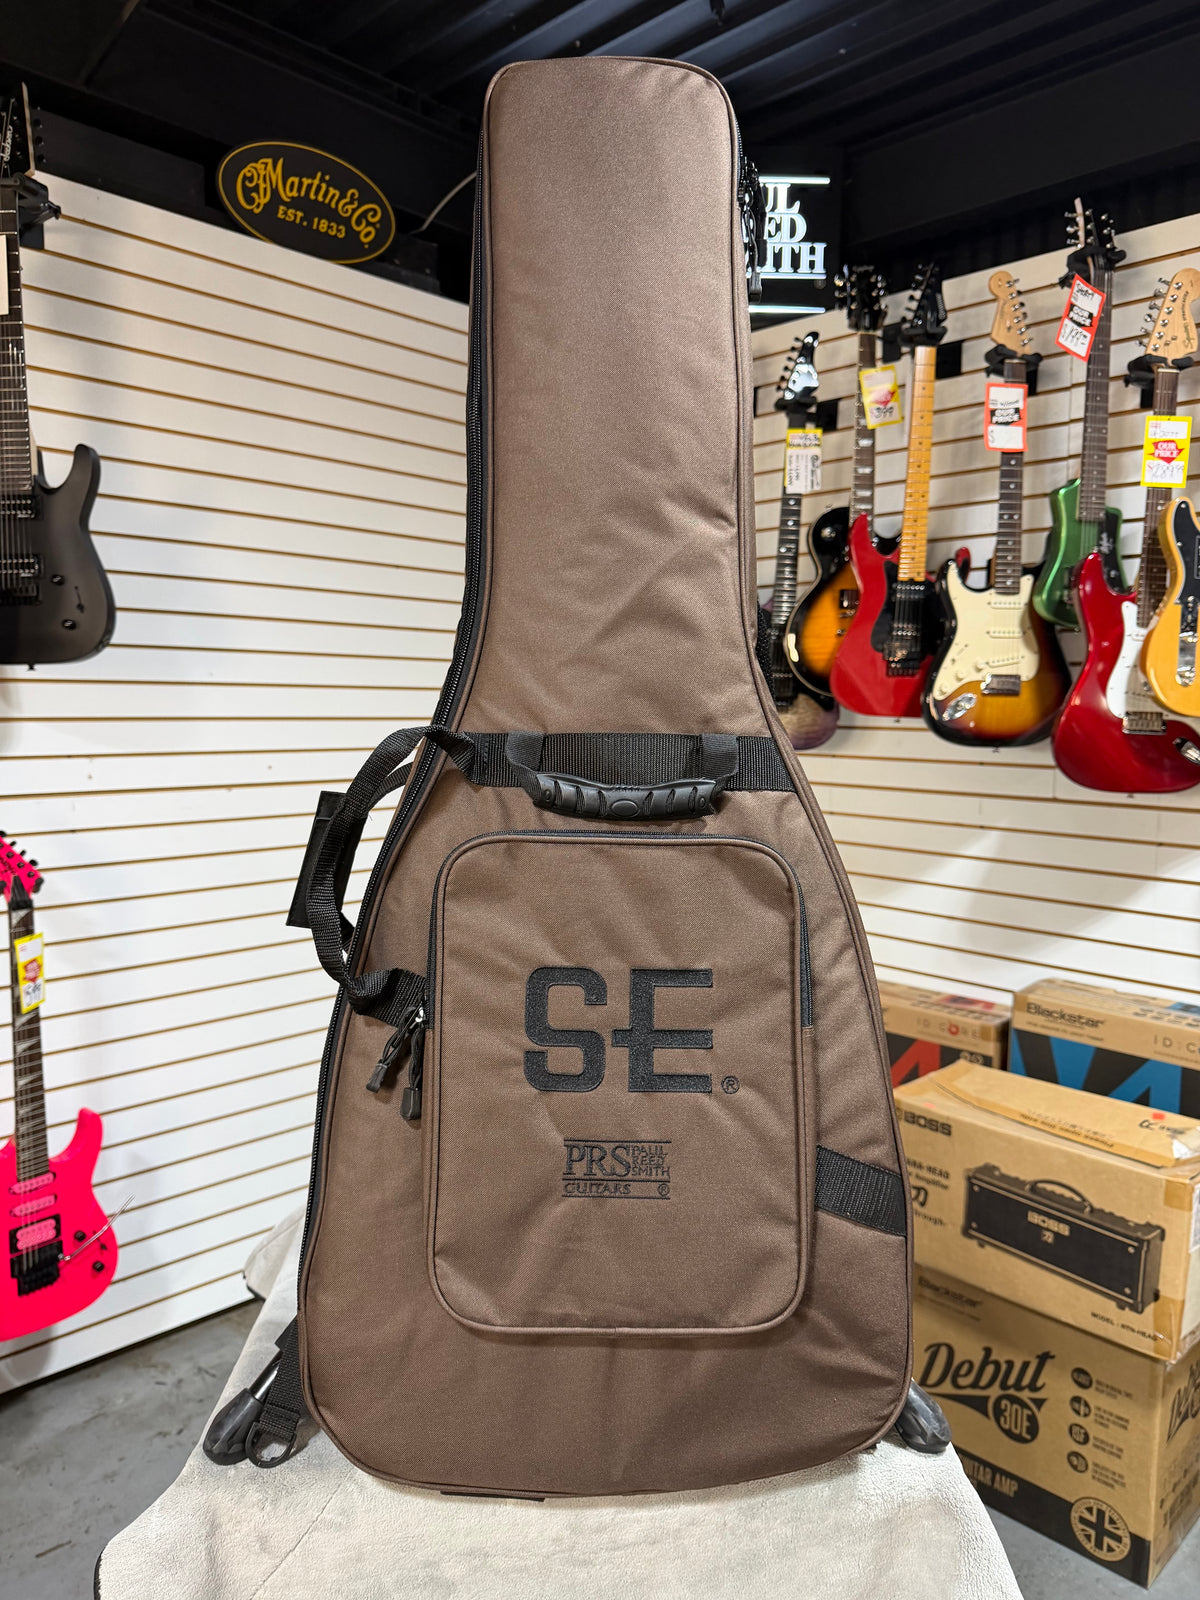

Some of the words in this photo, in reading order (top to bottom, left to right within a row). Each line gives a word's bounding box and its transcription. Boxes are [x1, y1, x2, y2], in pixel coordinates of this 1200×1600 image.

[277, 205, 307, 227] EST.
[312, 217, 346, 239] 1833
[1026, 1002, 1105, 1029] Blackstar
[523, 966, 714, 1093] SE
[904, 1110, 952, 1137] BOSS
[563, 1144, 631, 1177] PRS
[631, 1145, 668, 1156] PAUL
[631, 1156, 667, 1166] REED
[631, 1165, 671, 1178] SMITH
[564, 1182, 631, 1195] GUITARS
[919, 1342, 1056, 1393] Debut
[1000, 1399, 1032, 1440] 30E
